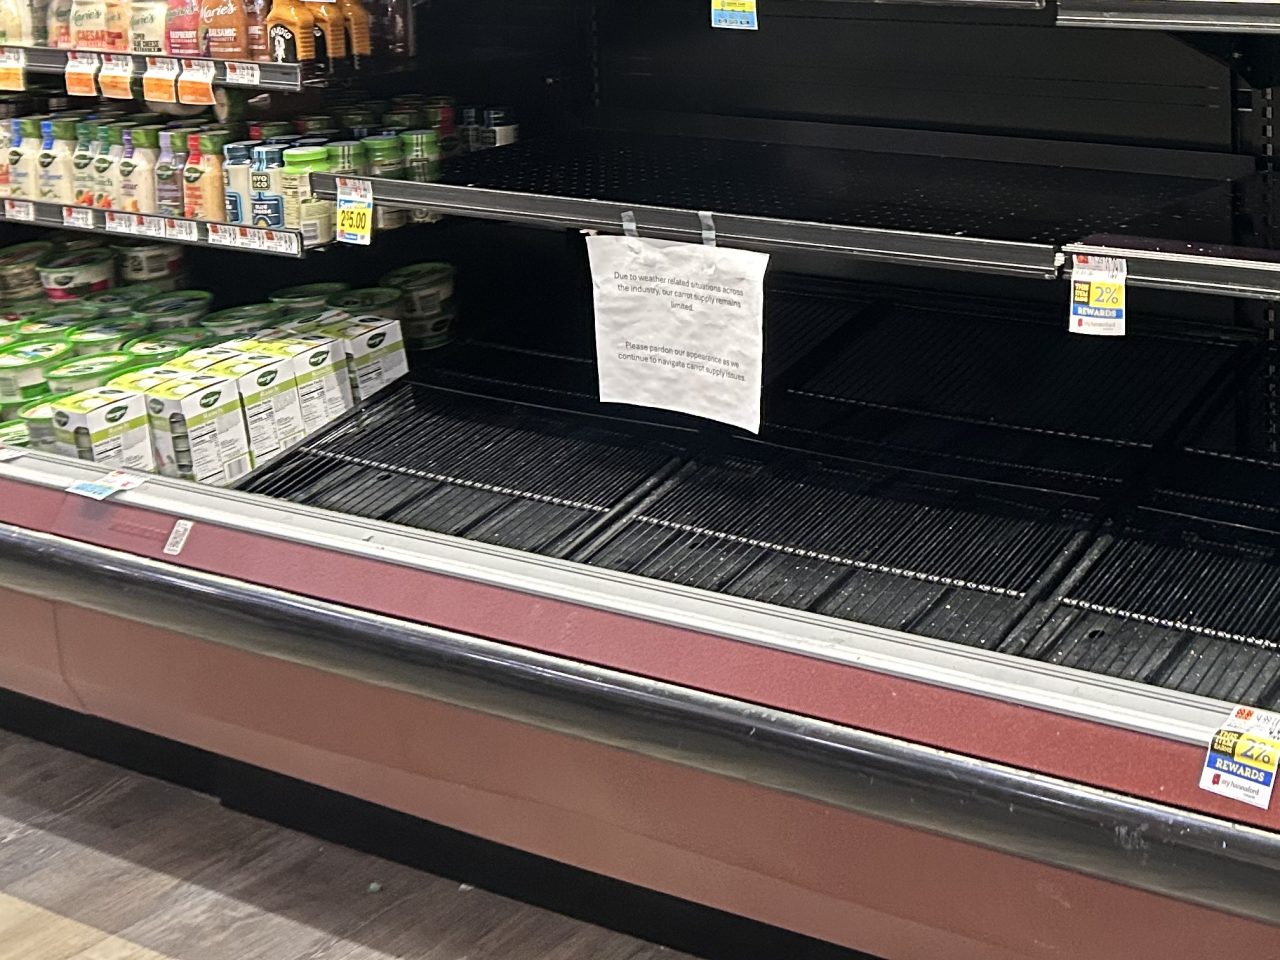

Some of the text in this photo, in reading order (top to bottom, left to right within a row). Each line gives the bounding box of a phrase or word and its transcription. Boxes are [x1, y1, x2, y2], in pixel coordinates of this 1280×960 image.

[614, 271, 628, 280] Due
[638, 275, 666, 284] weather
[667, 277, 689, 288] related
[690, 282, 721, 293] situations
[722, 287, 744, 296] across
[1094, 286, 1119, 305] 2%
[617, 284, 629, 292] the
[630, 285, 661, 296] industry,
[674, 291, 693, 300] carrot
[693, 294, 715, 304] supply
[715, 298, 741, 308] remains
[1077, 306, 1117, 317] REWARDS
[625, 341, 648, 351] Please
[649, 345, 673, 354] pardon
[686, 351, 721, 364] appearance
[722, 358, 730, 366] as
[617, 353, 746, 381] continue to navigate carrot supply issues.
[1215, 736, 1236, 747] ITEM
[1215, 758, 1265, 782] REWARDS
